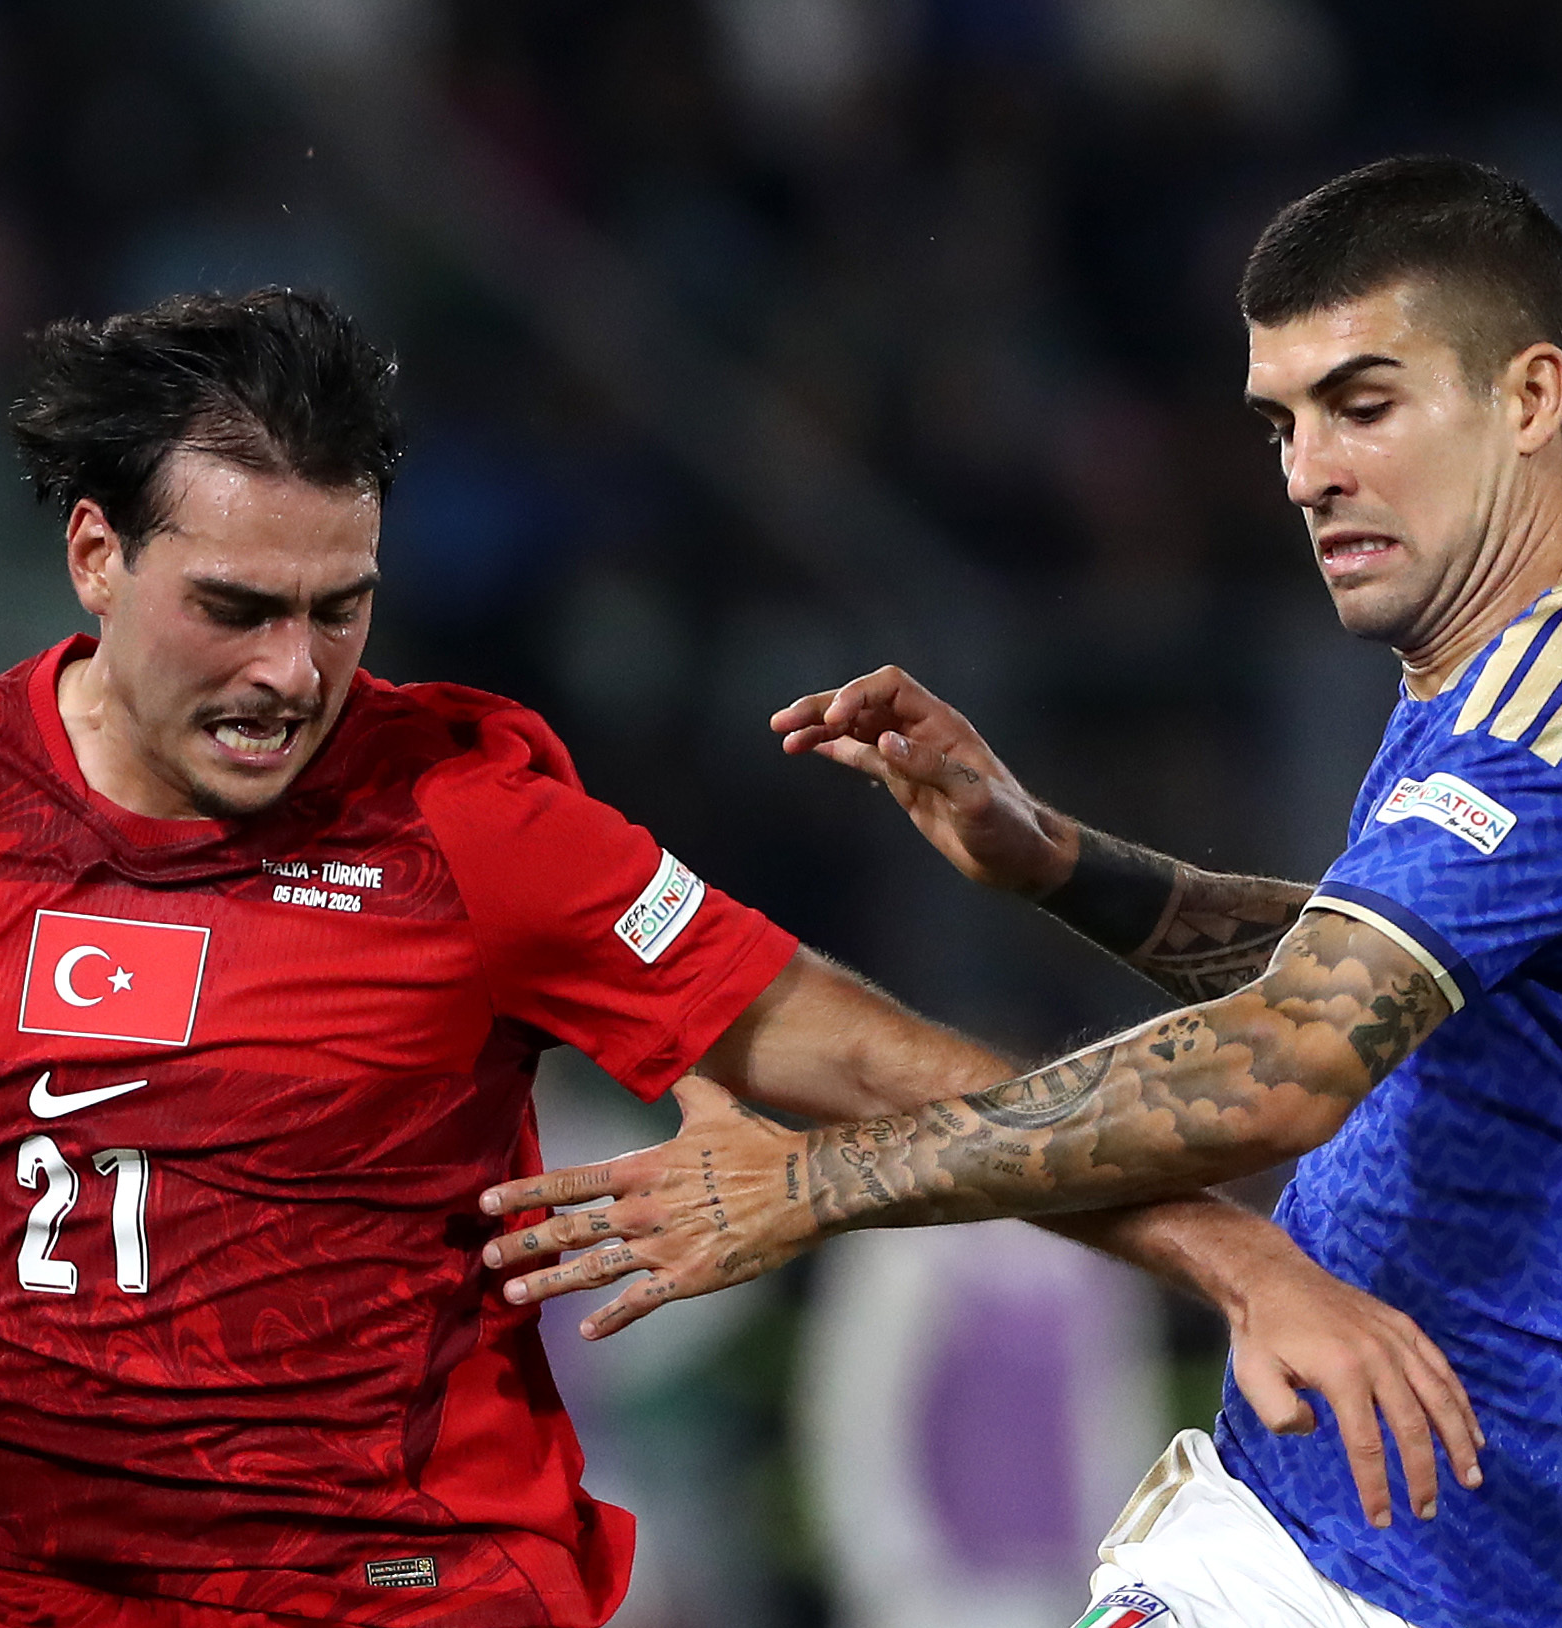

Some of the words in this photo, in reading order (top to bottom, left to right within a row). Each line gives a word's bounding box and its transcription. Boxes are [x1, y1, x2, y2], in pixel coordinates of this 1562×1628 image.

[321, 861, 383, 888] TÜRKİYE
[273, 885, 291, 902] 05
[292, 886, 328, 908] EKİM
[328, 895, 361, 912] 2026
[620, 903, 649, 935] UEFA
[16, 1134, 150, 1295] 21
